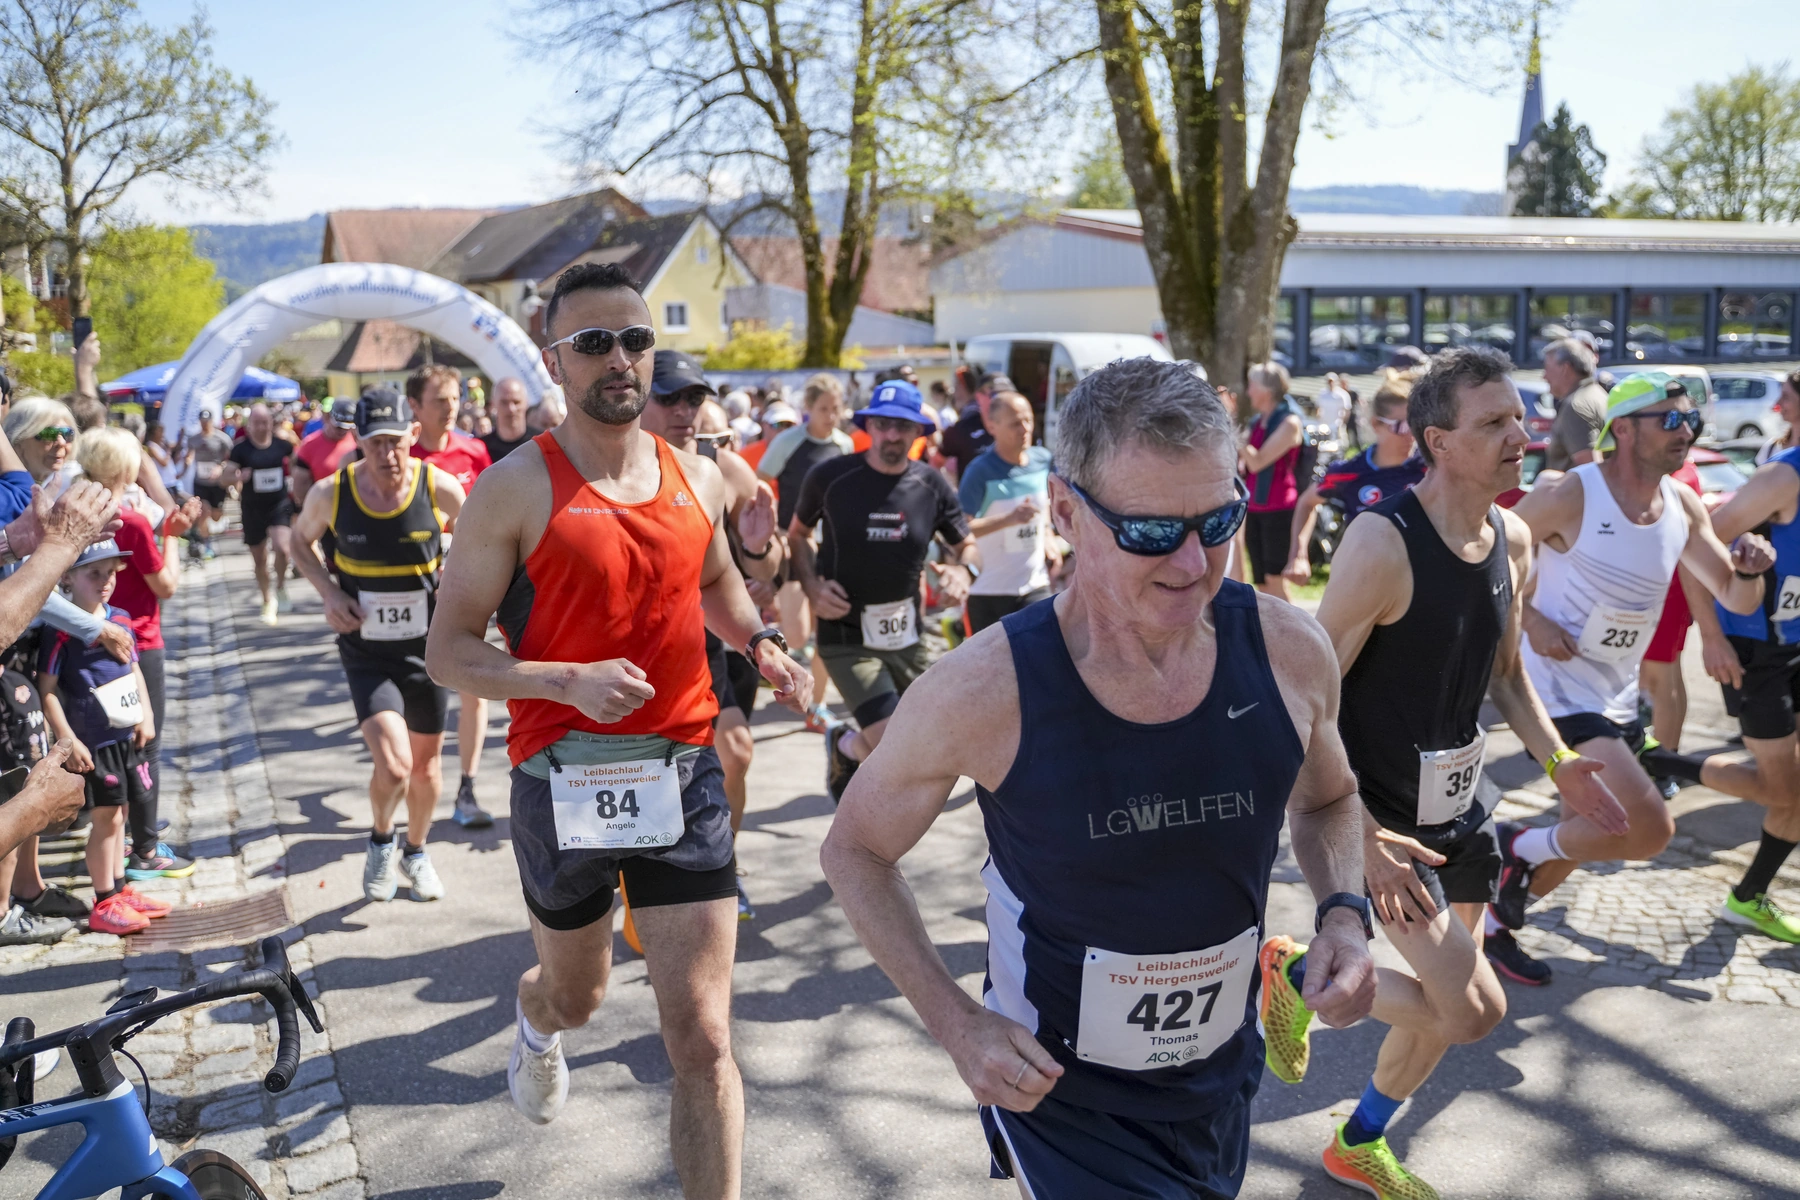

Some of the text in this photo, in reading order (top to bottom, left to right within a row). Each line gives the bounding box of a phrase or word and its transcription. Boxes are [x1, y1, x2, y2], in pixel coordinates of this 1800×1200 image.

[376, 606, 412, 624] 134
[879, 615, 907, 636] 306
[1600, 628, 1639, 648] 233
[584, 765, 644, 777] Leiblachlauf
[590, 775, 661, 787] Hergensweiler
[595, 789, 640, 819] 84
[606, 822, 636, 831] Angelo
[634, 835, 659, 845] AOK
[1137, 950, 1224, 972] Leiblachlauf
[1109, 957, 1239, 986] TSV Hergensweiler
[1126, 980, 1223, 1032] 427
[1150, 1033, 1199, 1046] Thomas
[1145, 1050, 1181, 1063] AOK
